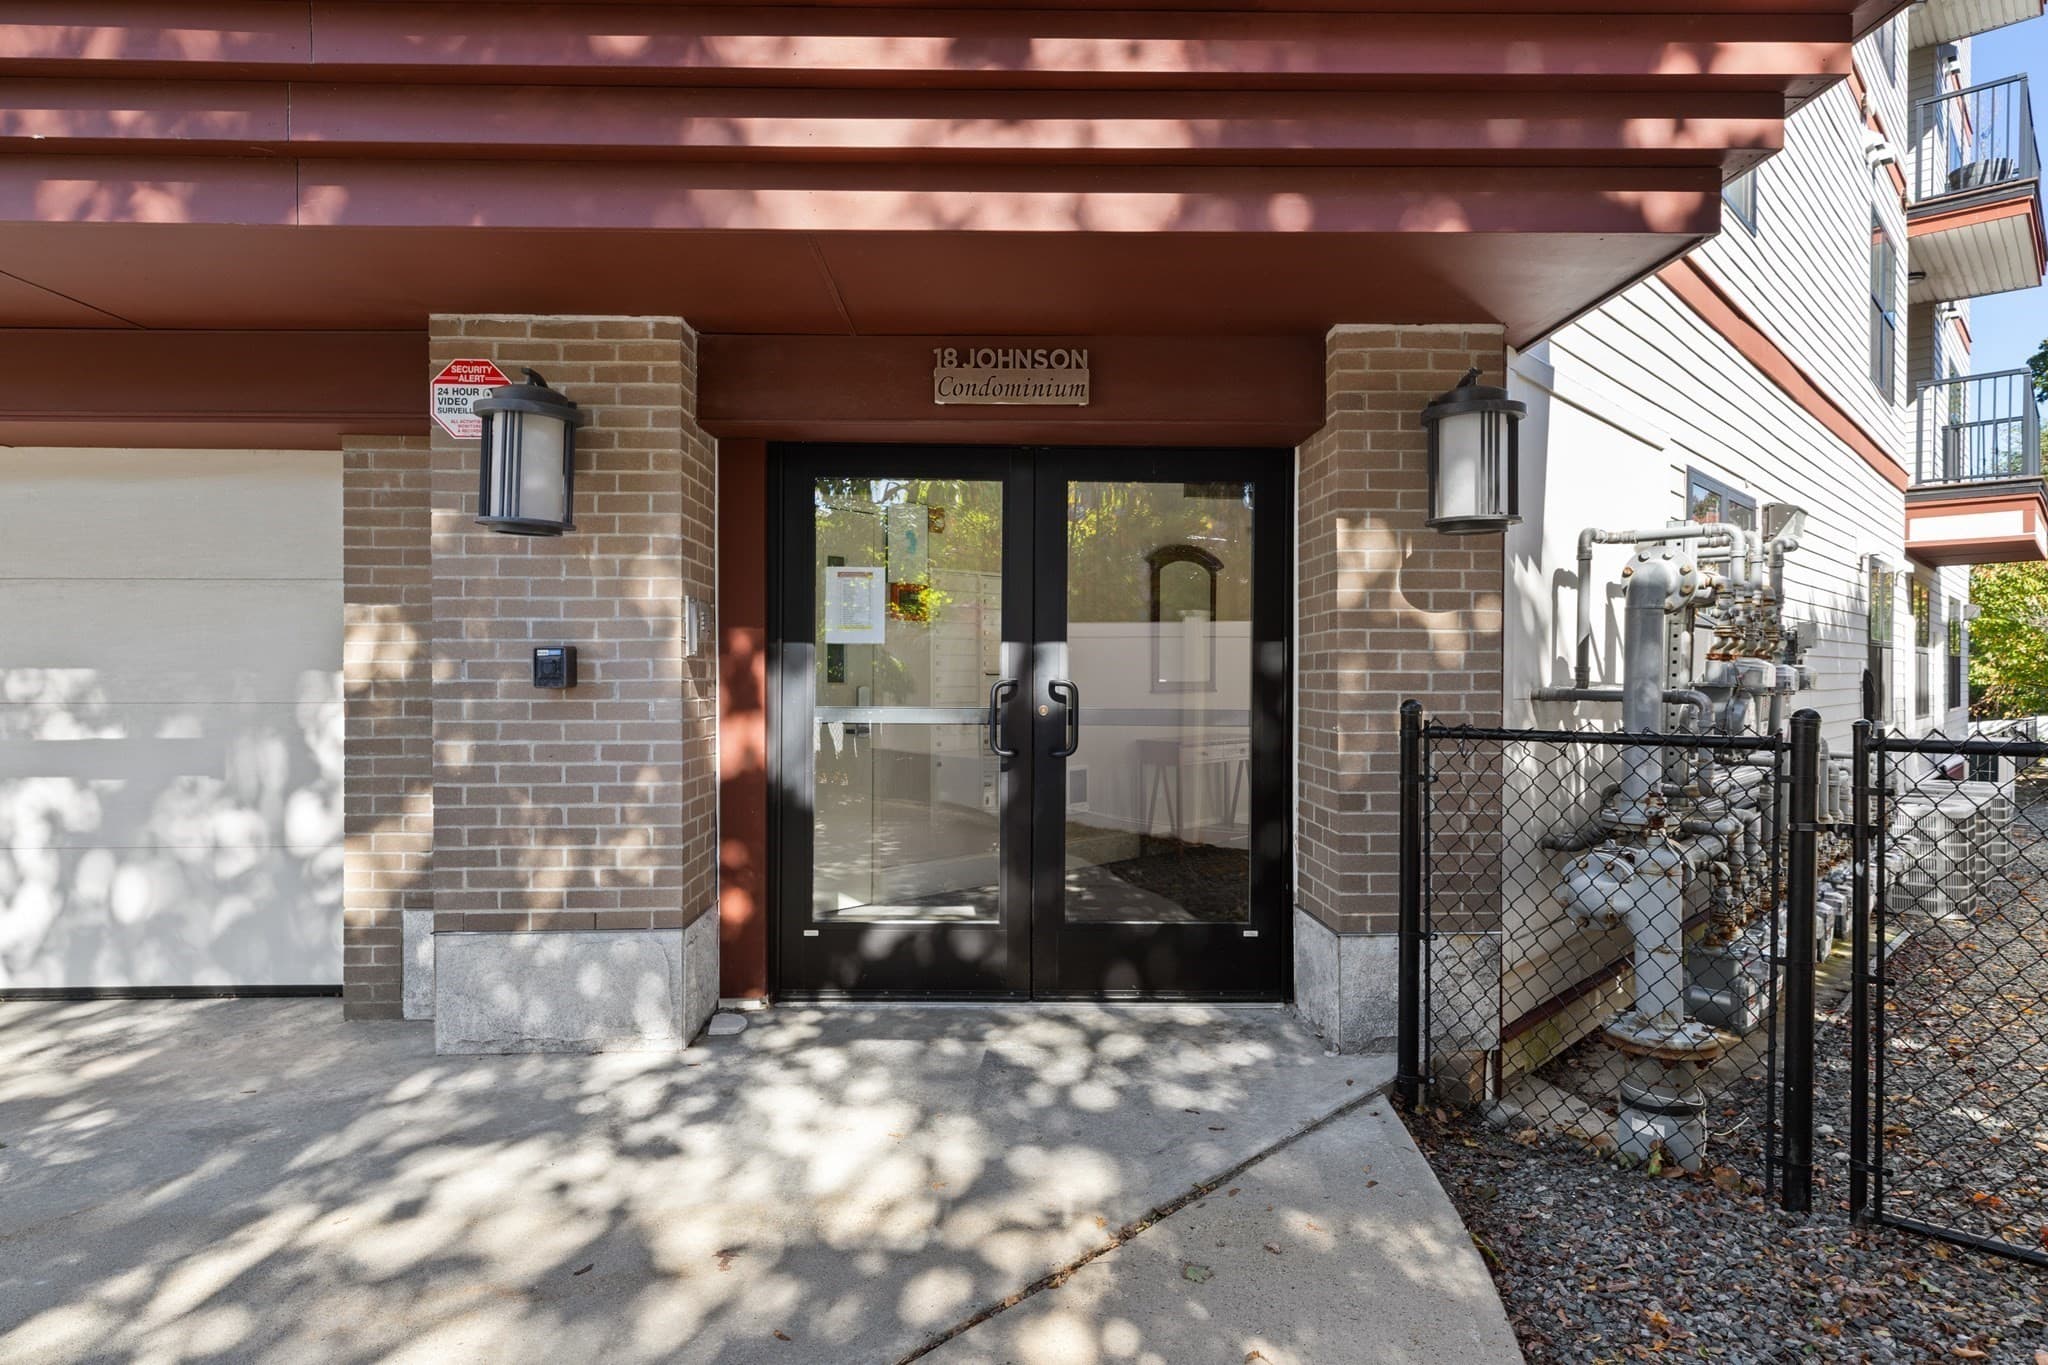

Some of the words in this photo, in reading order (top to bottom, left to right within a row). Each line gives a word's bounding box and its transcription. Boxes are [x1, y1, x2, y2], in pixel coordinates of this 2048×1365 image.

[933, 348, 958, 369] 18
[962, 348, 1088, 369] JOHNSON
[451, 365, 492, 374] SECURITY
[458, 374, 485, 382] ALERT
[937, 375, 1086, 398] Condominium
[437, 387, 449, 396] 24
[452, 387, 480, 396] HOUR
[437, 397, 468, 406] VIDEO
